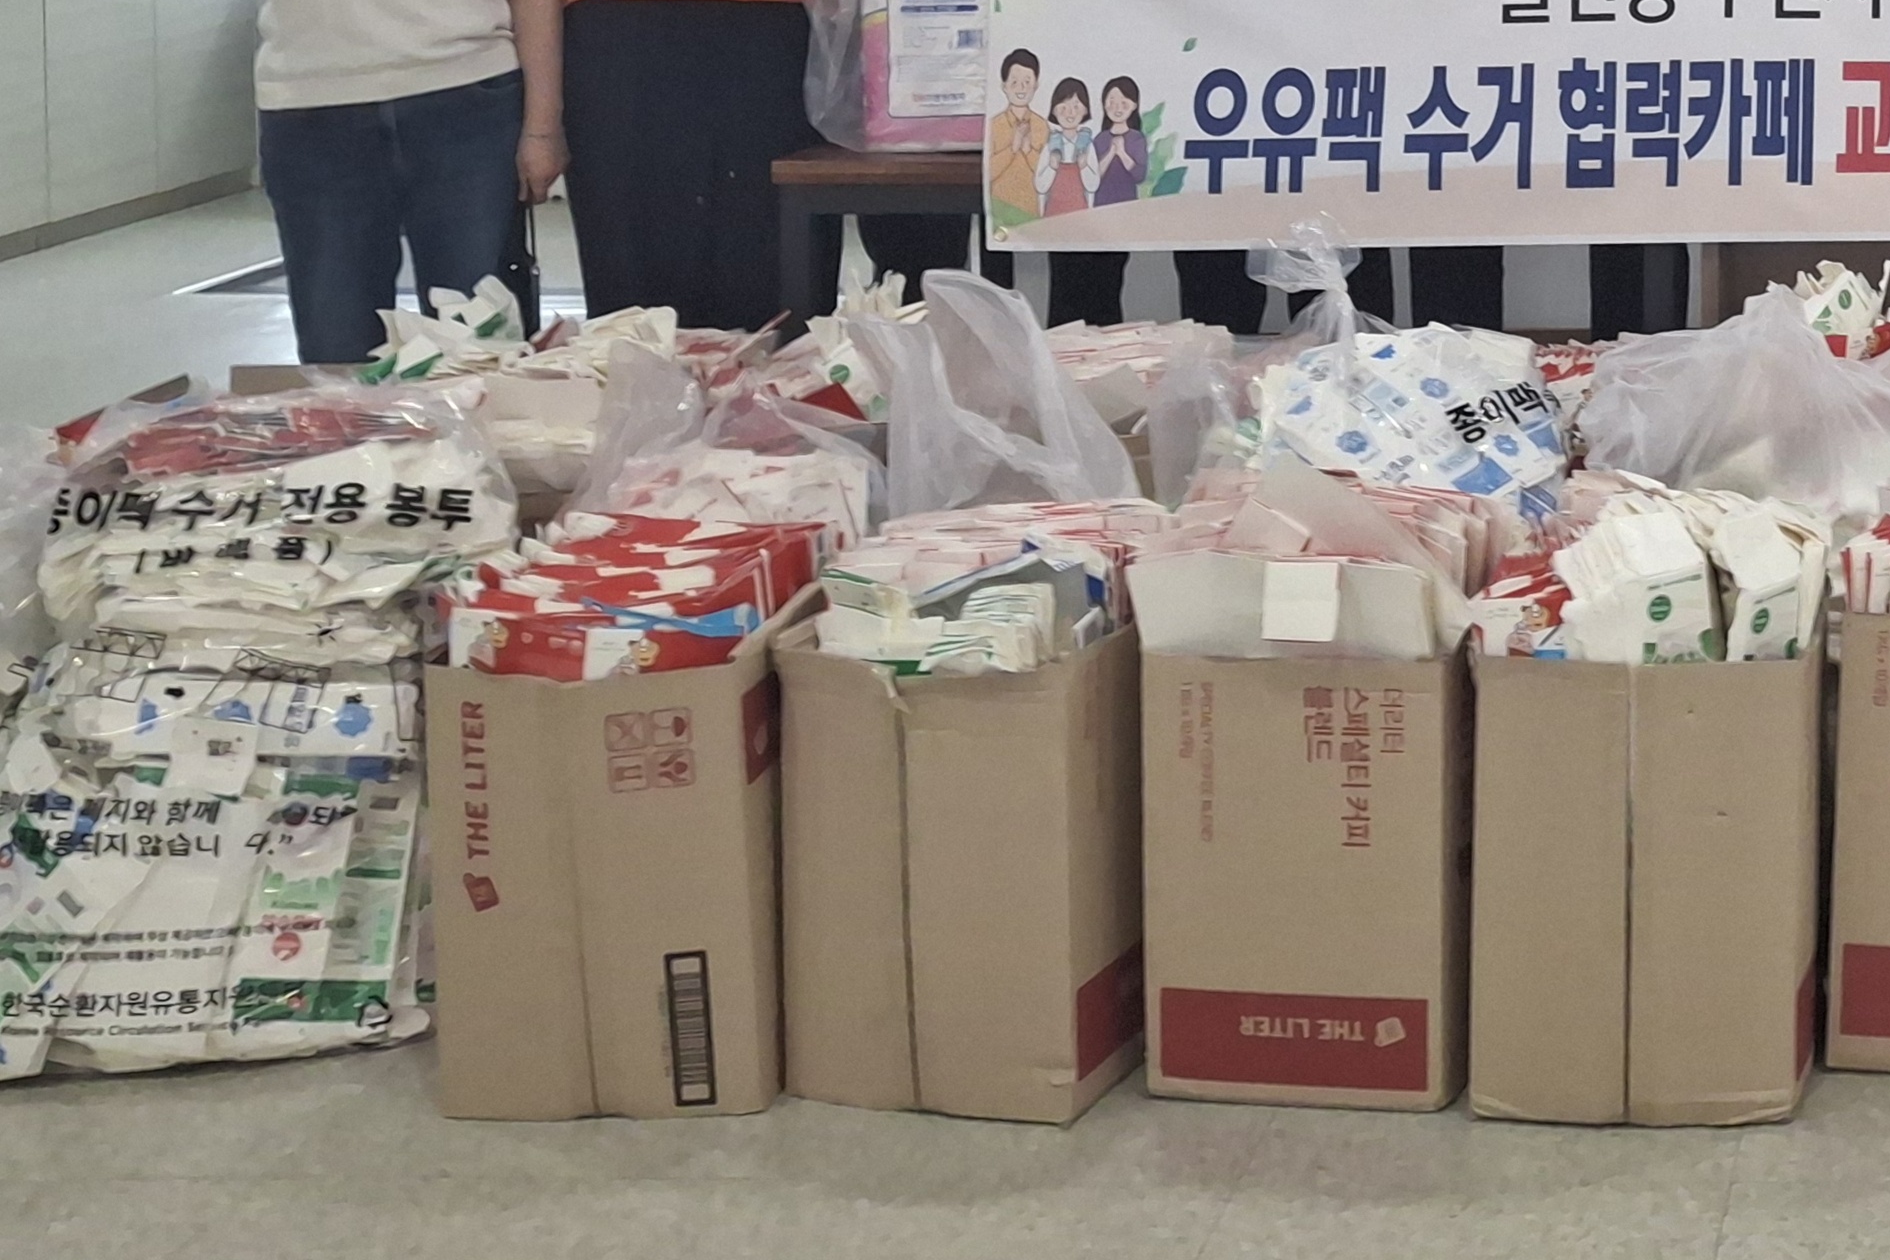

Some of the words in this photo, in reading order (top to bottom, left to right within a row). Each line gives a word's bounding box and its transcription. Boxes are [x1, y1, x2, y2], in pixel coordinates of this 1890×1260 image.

[1183, 65, 1388, 195] 우유팩
[1403, 61, 1535, 191] 수거
[1557, 57, 1815, 190] 협력카페
[1444, 380, 1550, 444] 종이팩
[385, 482, 475, 531] 봉투
[459, 700, 488, 790] LITER
[1379, 687, 1406, 754] 더리터
[166, 799, 221, 826] 함께
[463, 798, 490, 861] THE
[1340, 796, 1372, 847] 커피
[1239, 1014, 1310, 1040] LITER
[1319, 1018, 1366, 1042] THE
